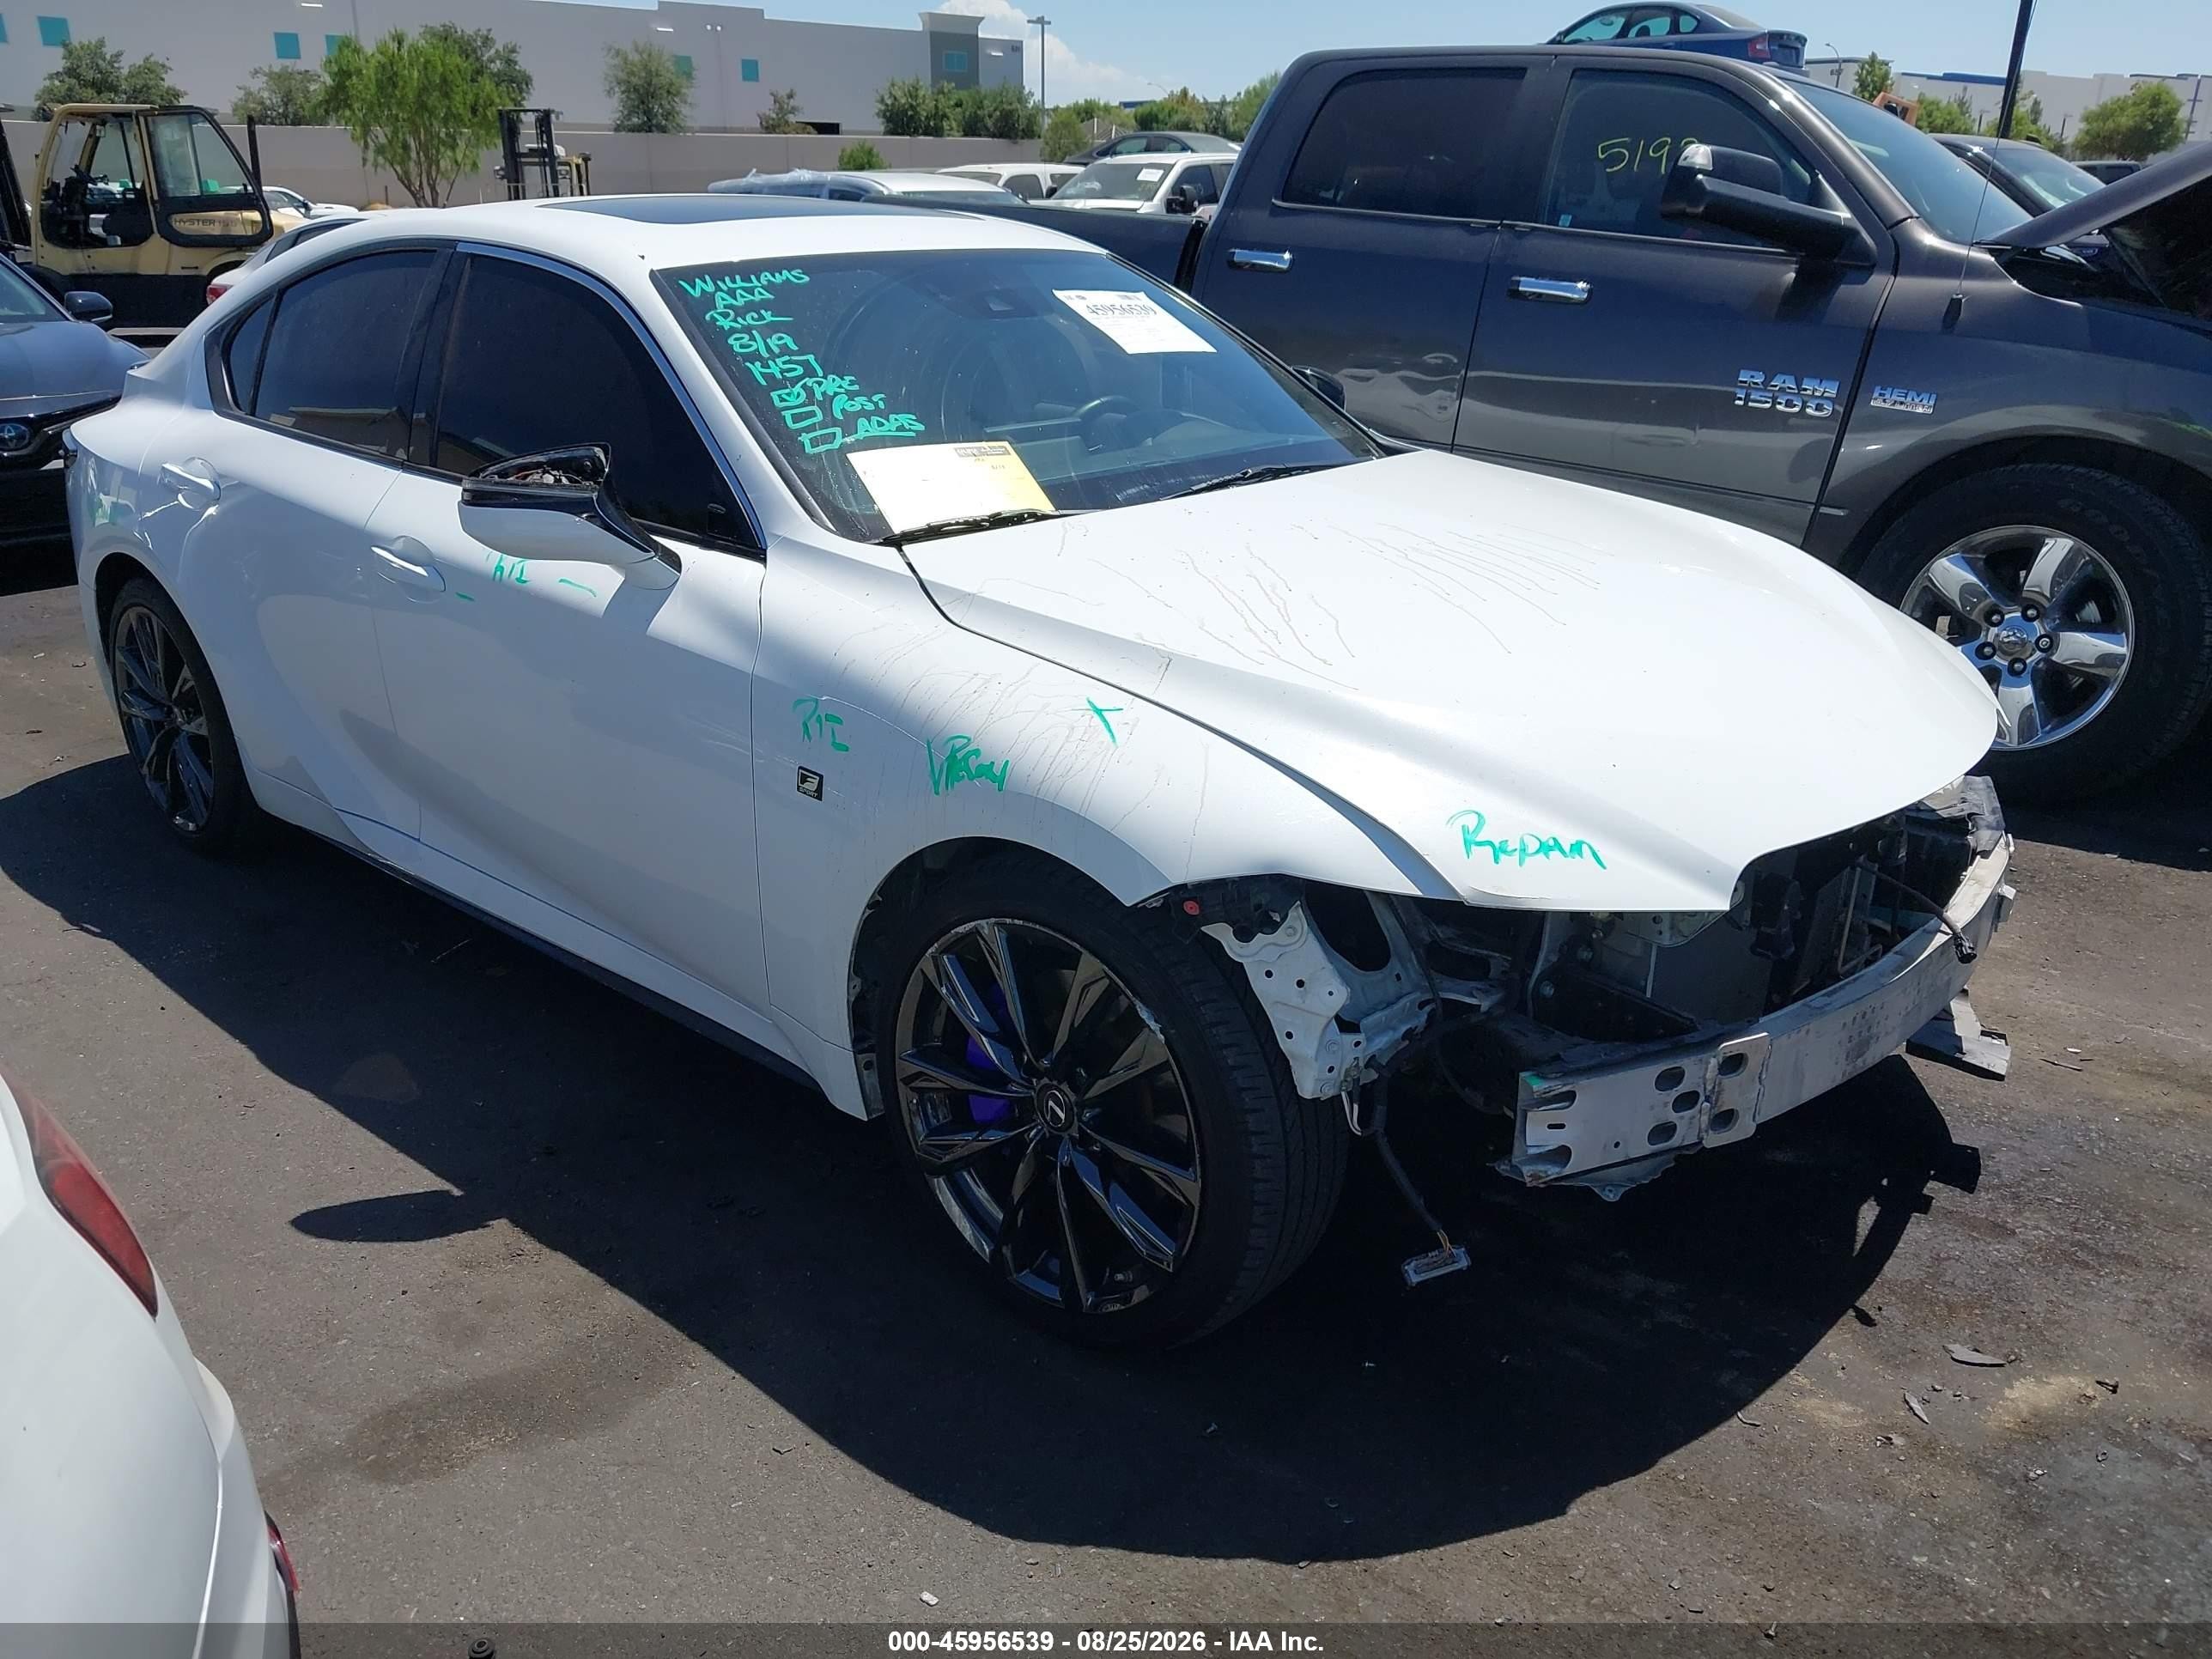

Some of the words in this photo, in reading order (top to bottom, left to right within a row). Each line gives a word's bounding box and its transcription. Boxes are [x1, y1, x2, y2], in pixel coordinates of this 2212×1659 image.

[174, 218, 216, 227] HYSTER
[714, 287, 775, 310] AAA
[727, 330, 799, 357] 8/19
[744, 354, 823, 386] 1457
[1737, 369, 1841, 398] RAM
[1734, 387, 1834, 418] 1500
[1872, 386, 1937, 404] HEMI
